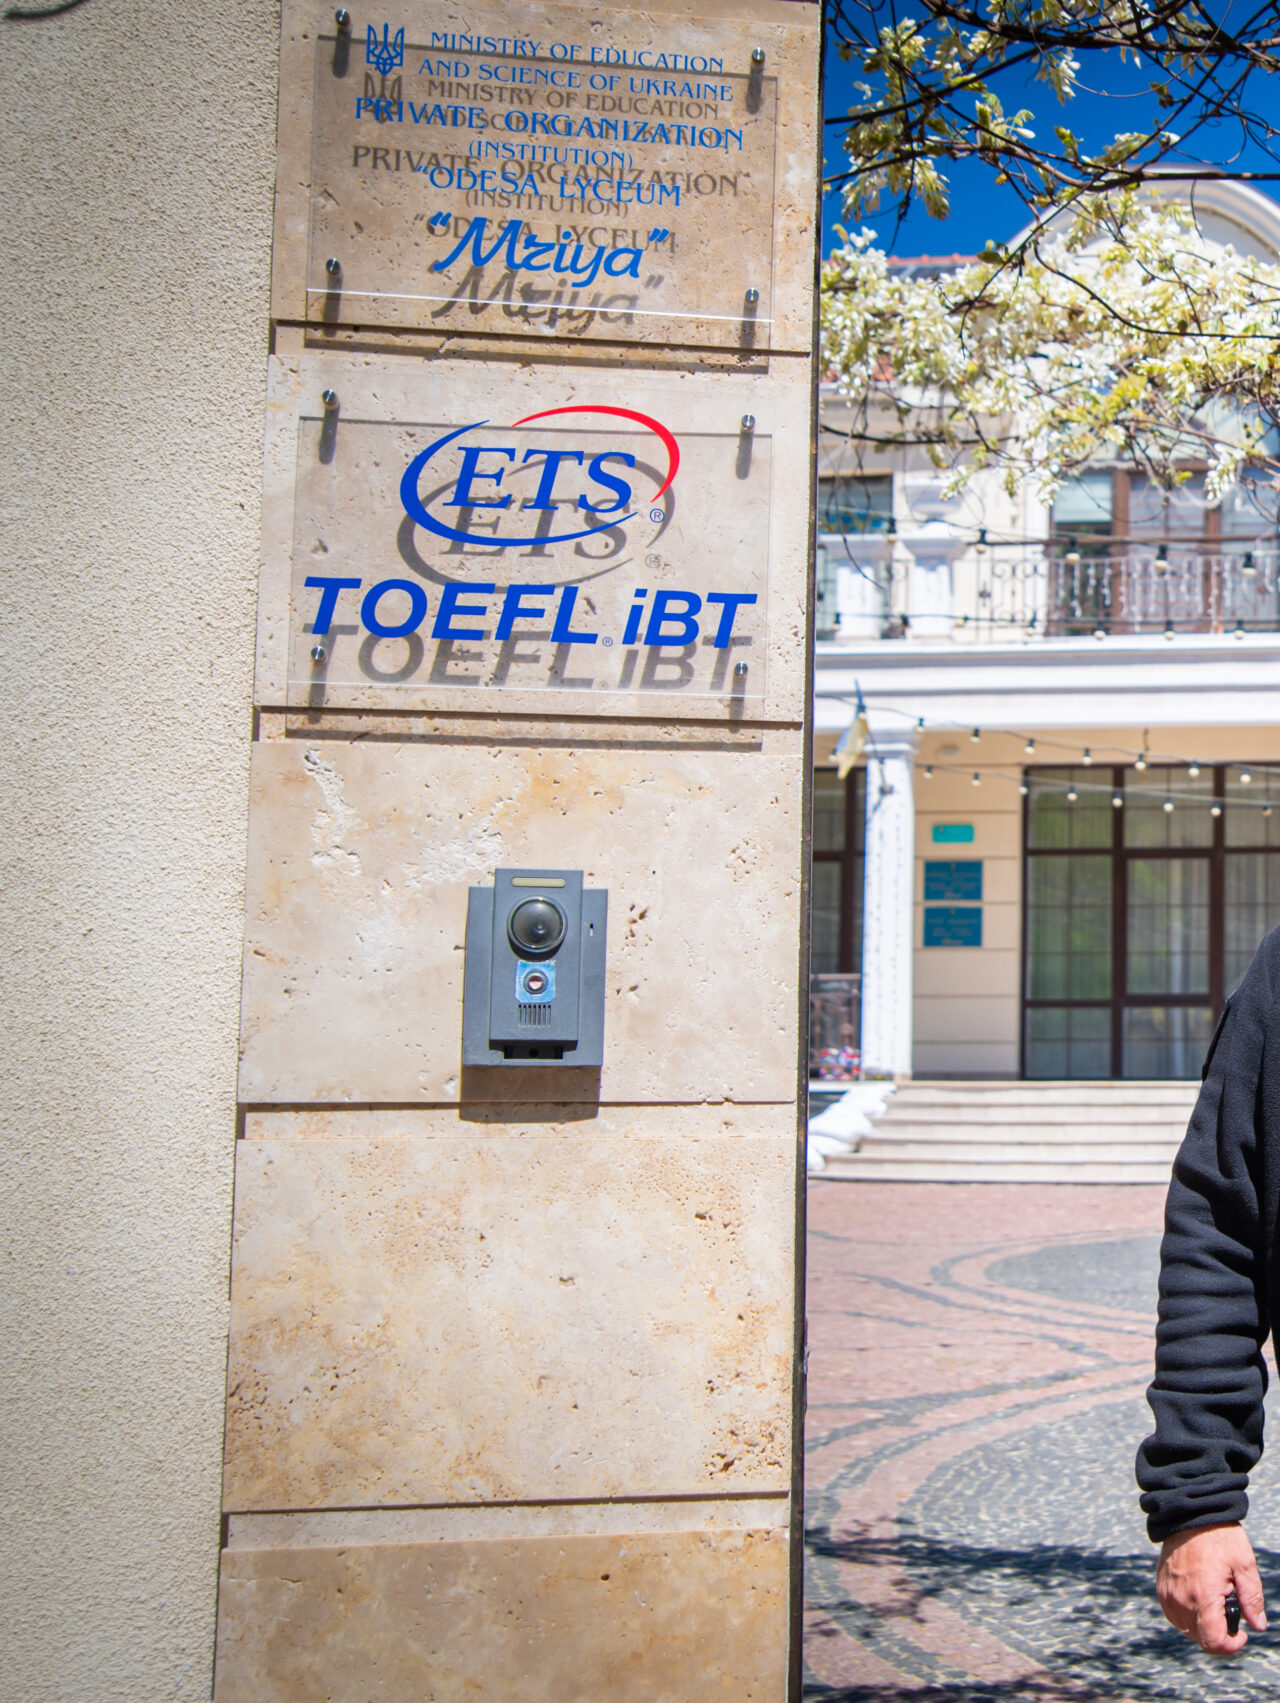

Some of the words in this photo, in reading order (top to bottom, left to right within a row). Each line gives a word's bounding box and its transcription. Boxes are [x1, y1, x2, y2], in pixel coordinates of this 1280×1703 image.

[431, 31, 540, 58] MINISTRY
[549, 43, 583, 61] OF
[590, 46, 724, 75] EDUCATION
[418, 58, 470, 79] AND
[479, 64, 583, 89] SCIENCE
[589, 74, 624, 93] OF
[628, 77, 734, 102] UKRAINE
[355, 97, 486, 130] PRIVATE
[504, 110, 744, 151] ORGANIZATION
[468, 140, 634, 170] (INSTITUTION)
[558, 175, 681, 207] LYCEUM
[442, 446, 636, 514] ETS
[303, 576, 599, 645] TOEFL
[621, 588, 758, 650] iBT
